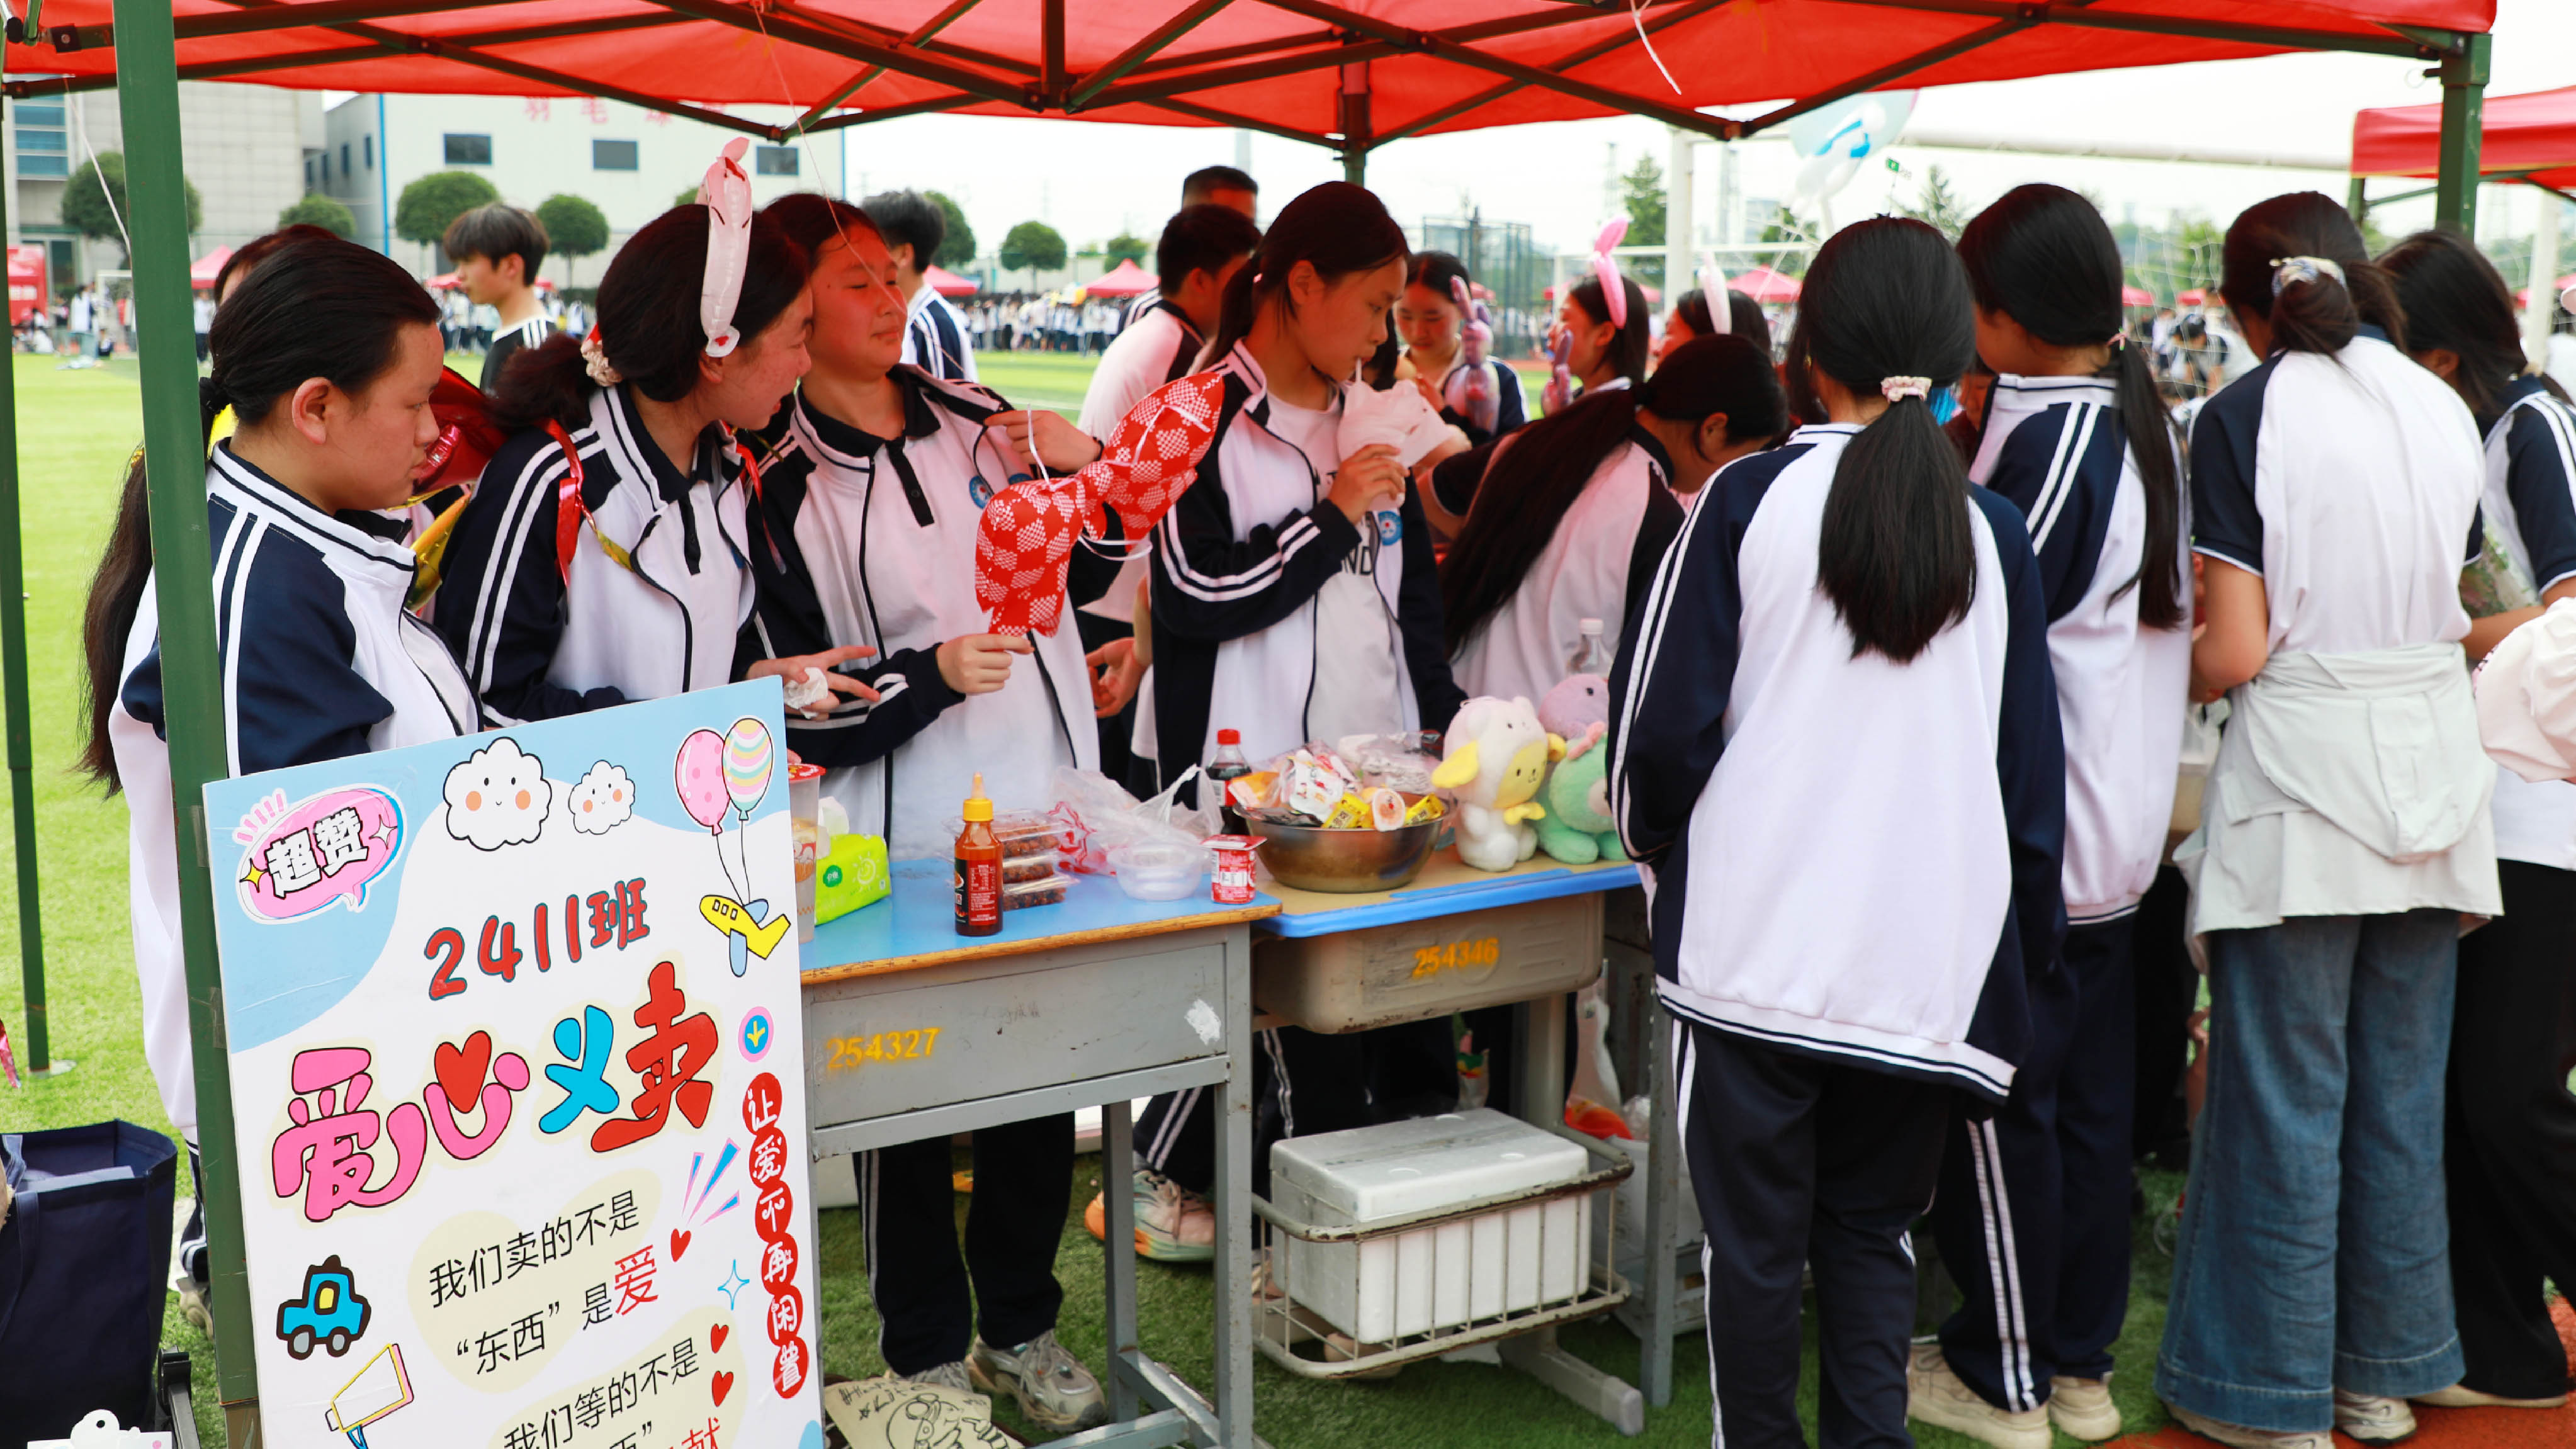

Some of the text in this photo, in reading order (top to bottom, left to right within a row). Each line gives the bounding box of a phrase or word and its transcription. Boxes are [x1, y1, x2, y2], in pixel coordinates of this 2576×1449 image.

[264, 808, 368, 899] 超赞
[426, 879, 650, 1000] 2411班
[1412, 938, 1499, 977] 254346
[272, 961, 719, 1222] 爱心义卖
[827, 1027, 940, 1069] 254327
[429, 1190, 640, 1308] 我们卖的不是
[747, 1088, 802, 1390] 让爱不再闲置
